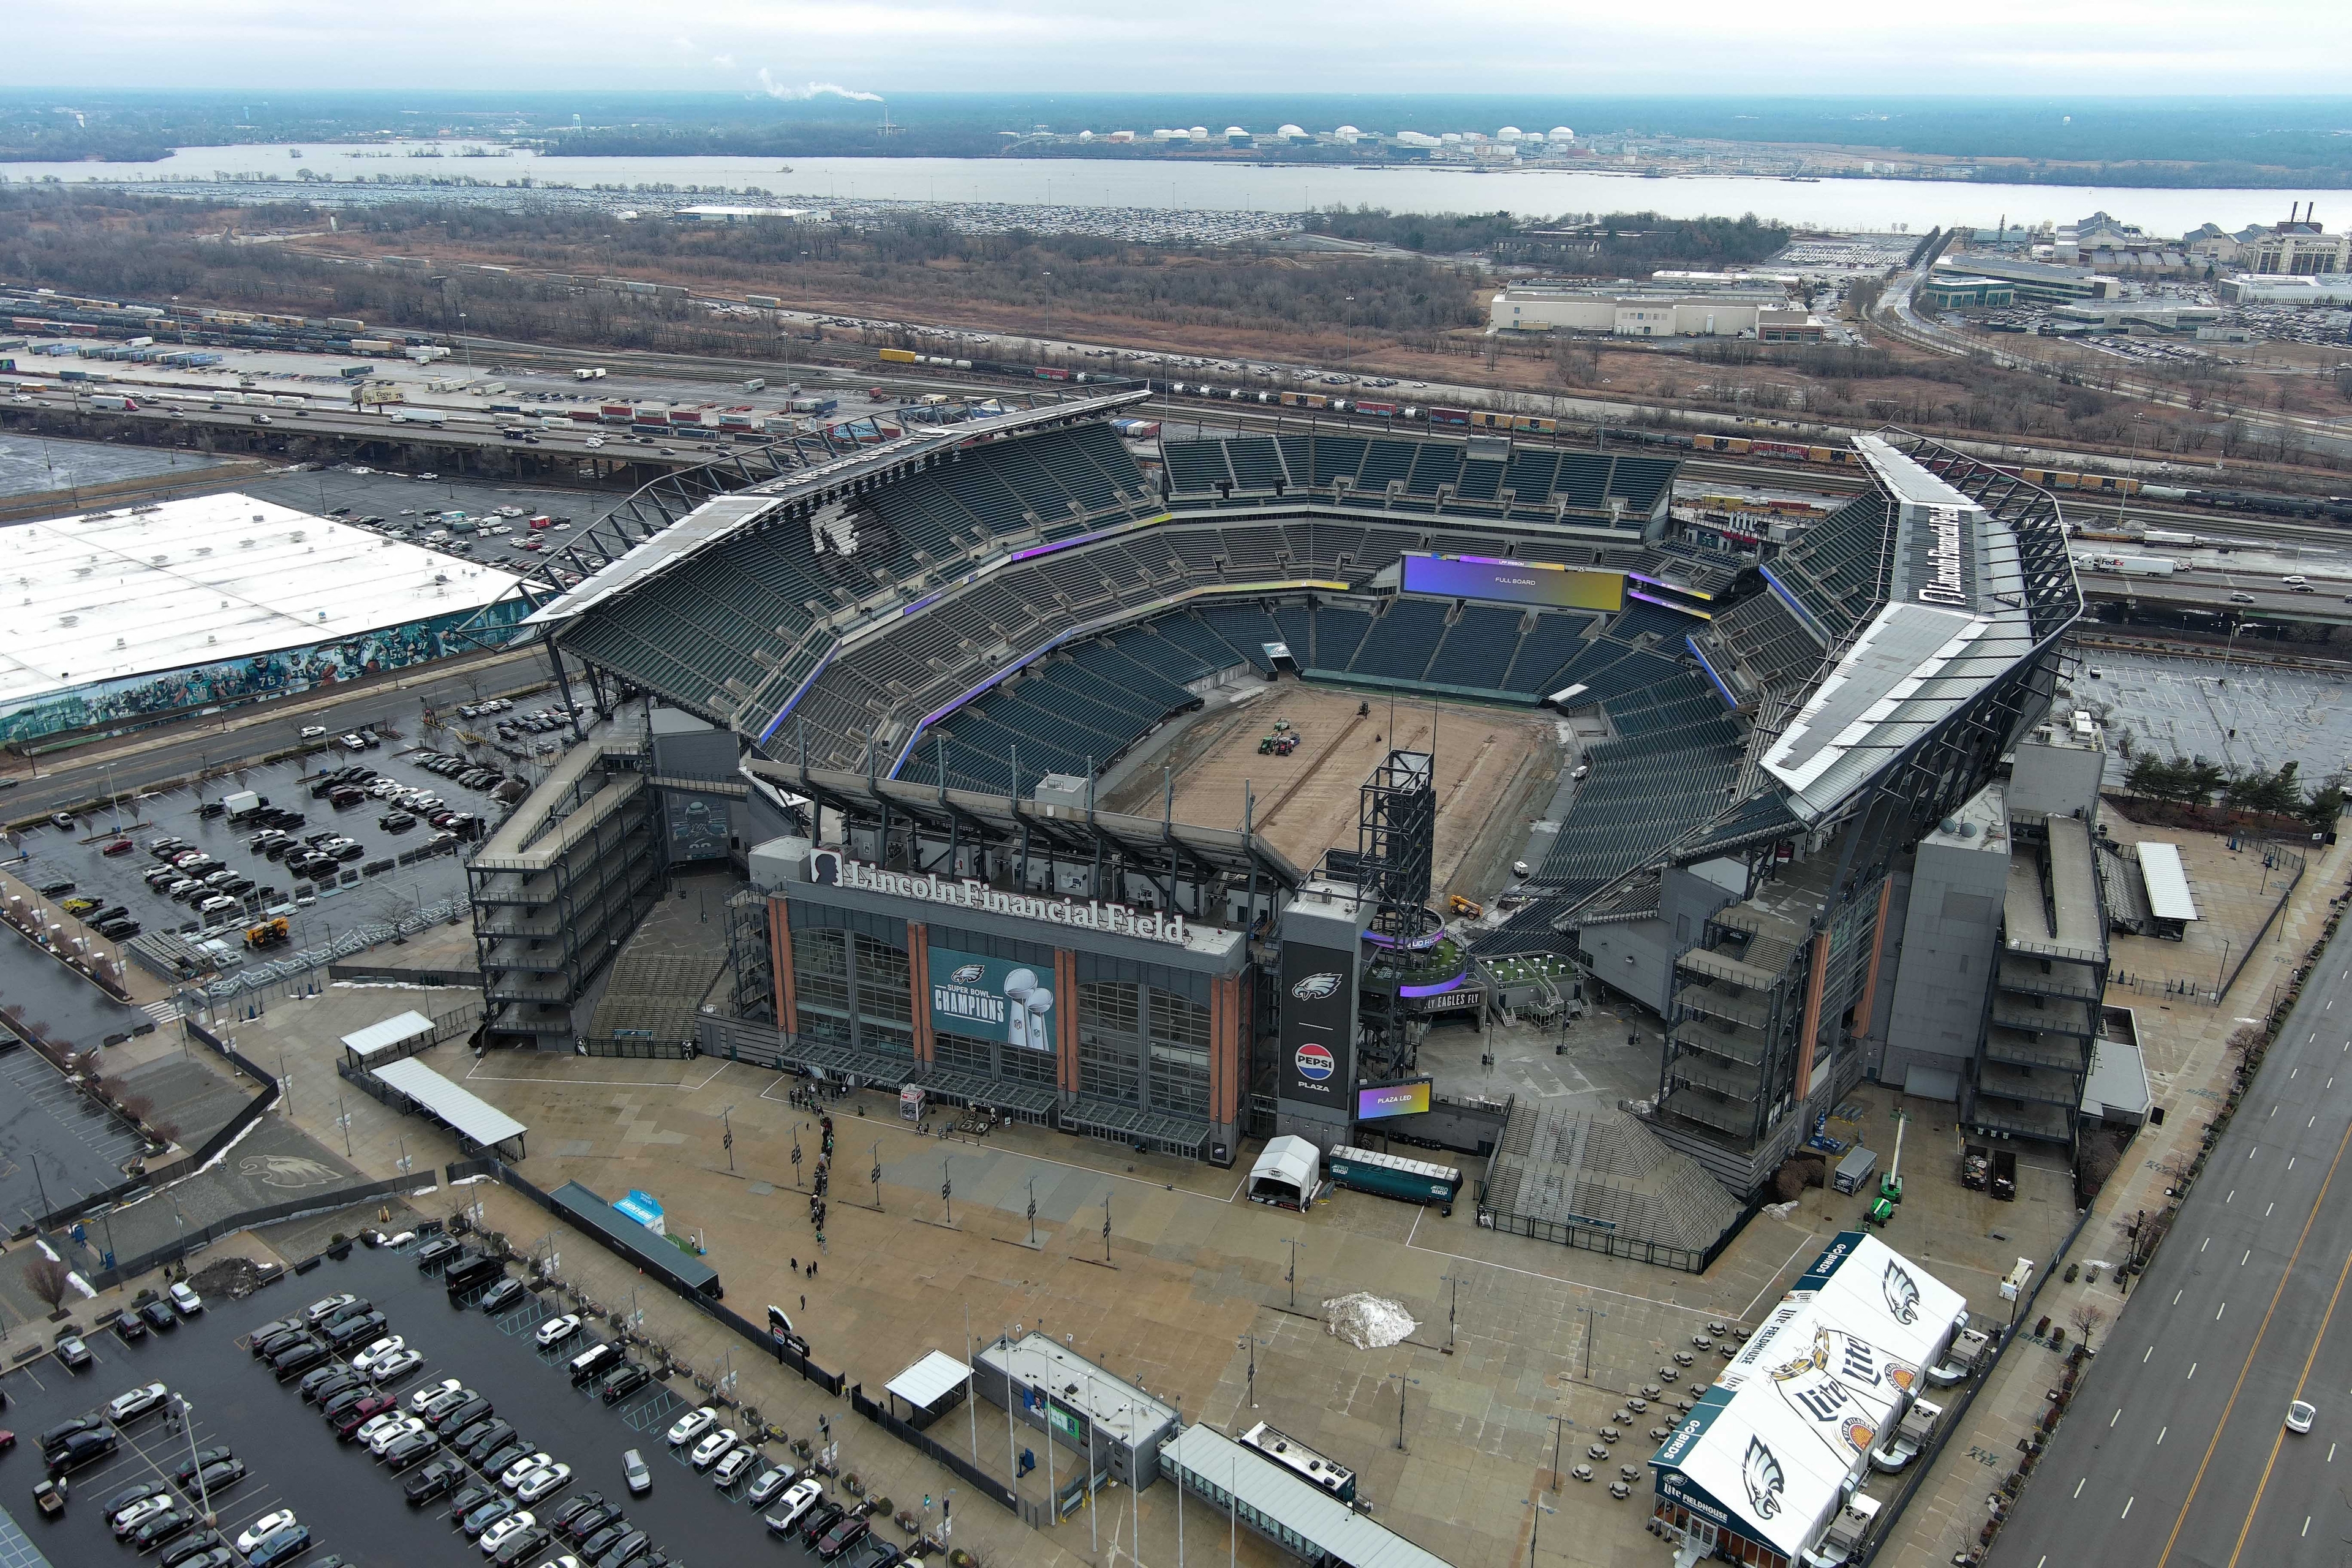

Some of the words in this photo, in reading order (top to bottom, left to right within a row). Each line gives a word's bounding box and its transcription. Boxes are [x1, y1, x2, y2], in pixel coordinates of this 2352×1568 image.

[2101, 558, 2125, 567] FedEx
[258, 676, 275, 687] 76
[850, 859, 958, 903] Lincoln
[962, 878, 1100, 928] Financial
[1105, 902, 1185, 943] Field
[948, 984, 968, 994] SUPER
[970, 987, 990, 998] BOWL
[935, 989, 1004, 1022] CHAMPIONS
[1438, 993, 1464, 1008] EAGLES
[1468, 993, 1479, 1005] FLY
[1298, 1055, 1332, 1069] PEPSI
[1298, 1081, 1330, 1093] PLAZA
[1833, 1244, 1846, 1254] GO
[1816, 1254, 1838, 1273] BIRDS
[1775, 1309, 1798, 1324] Lite
[1741, 1326, 1781, 1365] FIELDHOUSE
[1842, 1338, 1882, 1386] Lite
[1793, 1381, 1848, 1421] Lite
[1684, 1420, 1700, 1433] GO
[1664, 1433, 1690, 1460] BIRDS
[1664, 1483, 1681, 1498] Lite
[1683, 1493, 1728, 1521] FIELDHOUSE
